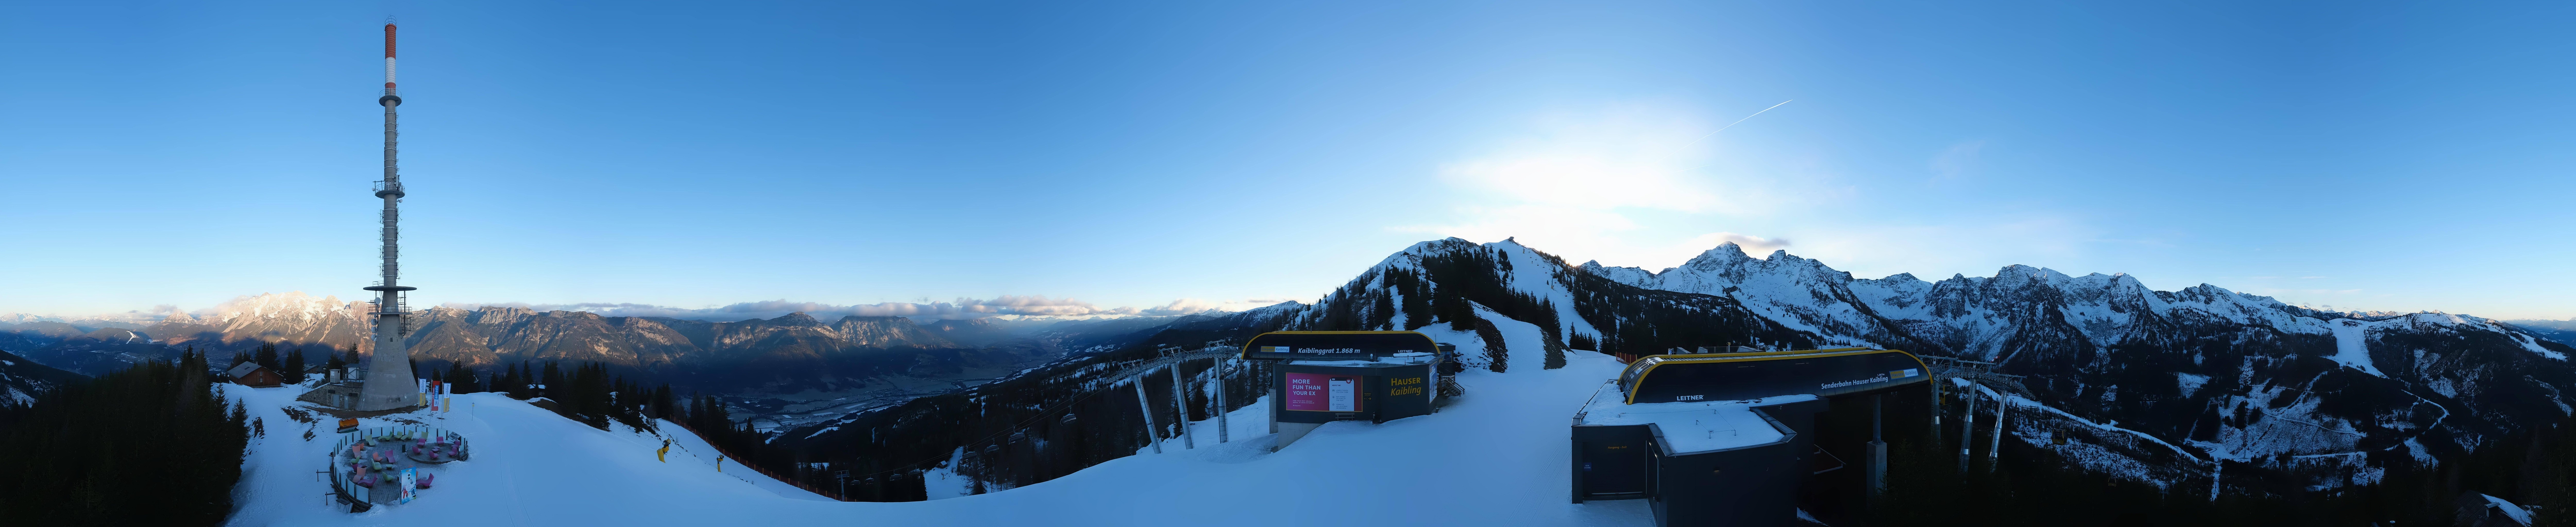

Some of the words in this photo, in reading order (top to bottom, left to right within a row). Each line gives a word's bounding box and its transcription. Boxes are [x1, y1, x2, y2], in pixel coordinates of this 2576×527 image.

[1391, 377, 1421, 386] HAUSER
[1821, 380, 1852, 389] Senderbahn
[1391, 386, 1421, 396] Kaibling
